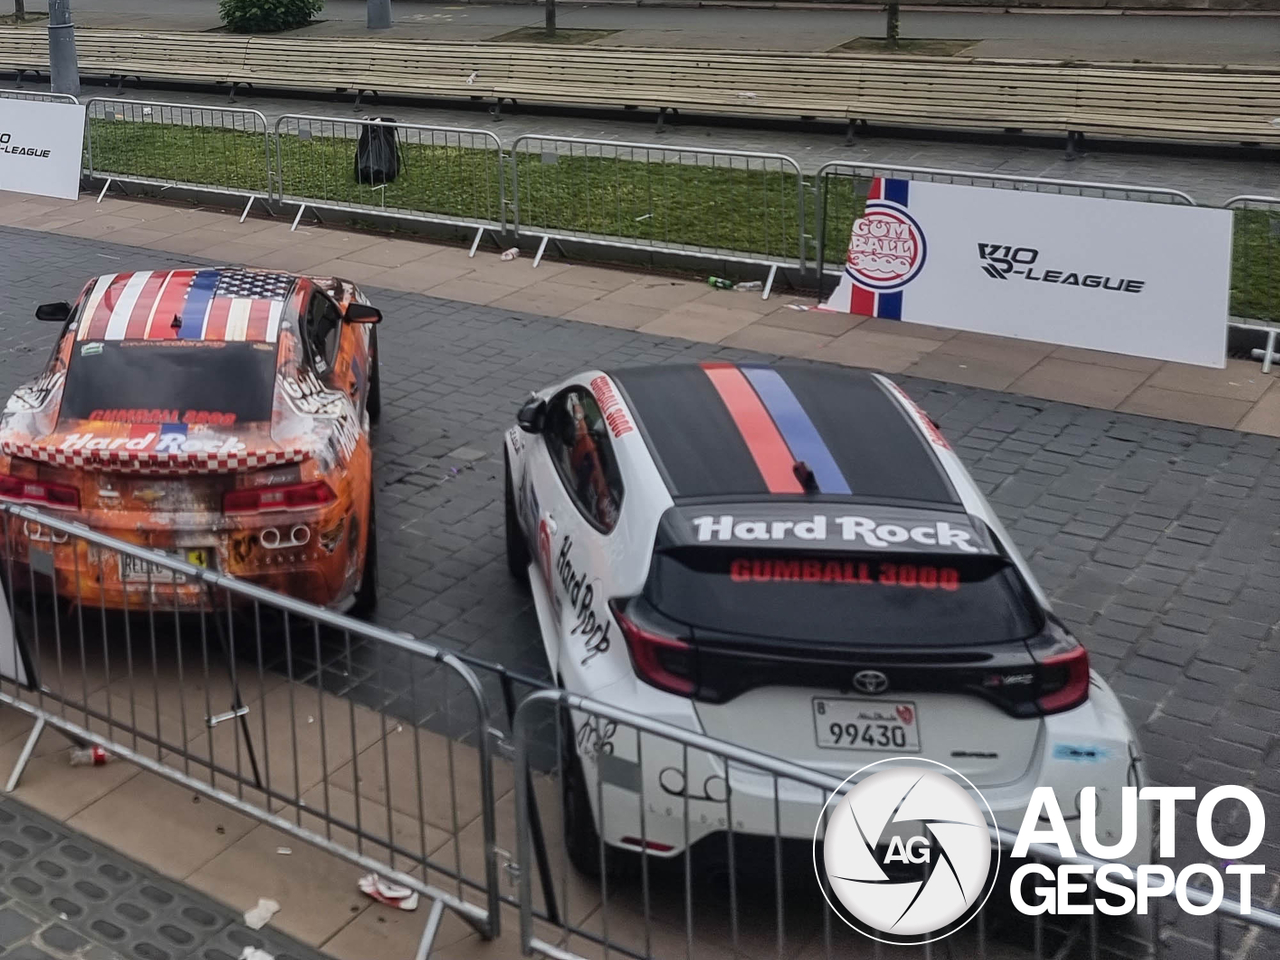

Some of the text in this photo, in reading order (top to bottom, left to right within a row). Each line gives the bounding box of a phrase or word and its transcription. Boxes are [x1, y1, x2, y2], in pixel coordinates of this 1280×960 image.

[852, 218, 911, 239] GUM
[850, 236, 912, 257] BALL
[847, 254, 912, 274] 3000
[88, 408, 180, 425] GUMBALL
[589, 375, 634, 439] GUMBALL 3000
[59, 432, 247, 455] Hard Rock
[692, 515, 978, 553] Hard Rock
[556, 534, 588, 610] Hard
[730, 559, 960, 591] GUMBALL 3000
[570, 583, 611, 668] Rock
[829, 722, 907, 748] 99430
